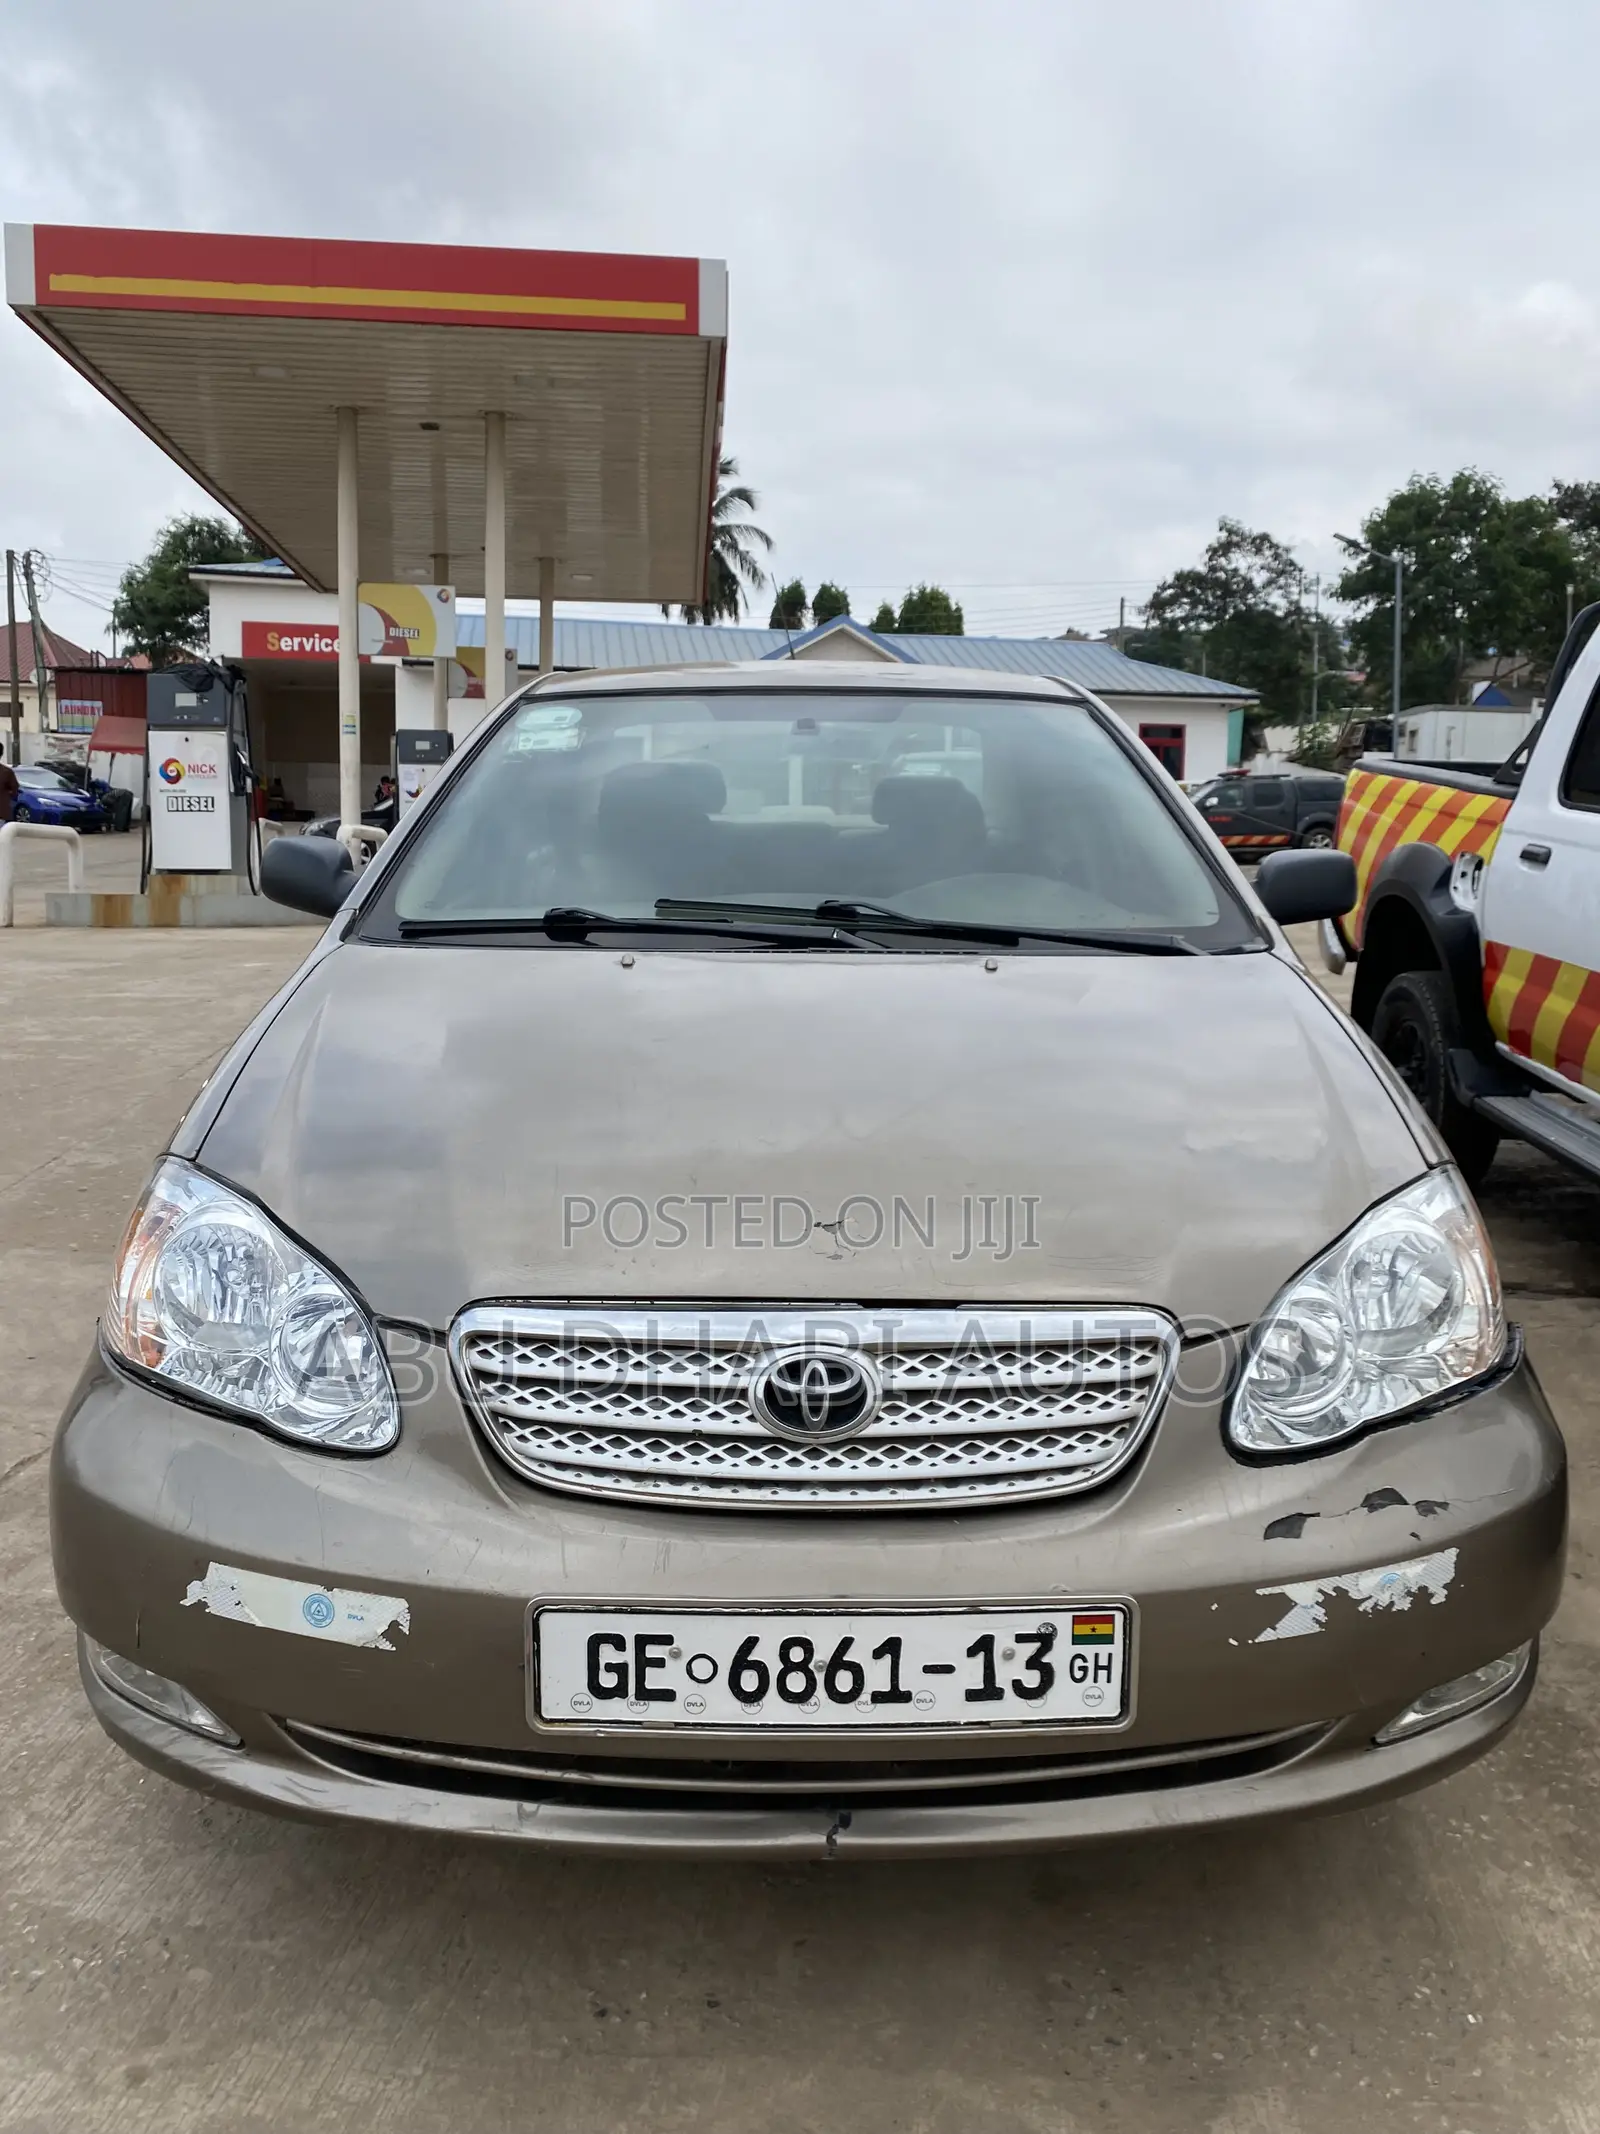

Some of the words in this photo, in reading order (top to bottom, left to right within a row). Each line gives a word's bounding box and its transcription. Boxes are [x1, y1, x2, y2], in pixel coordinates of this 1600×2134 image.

[389, 627, 419, 638] DIESEL
[187, 764, 216, 774] NICK
[167, 796, 214, 812] DIESEL
[587, 1633, 676, 1702] GE
[728, 1633, 1055, 1703] 6861-13
[1069, 1653, 1113, 1683] GH
